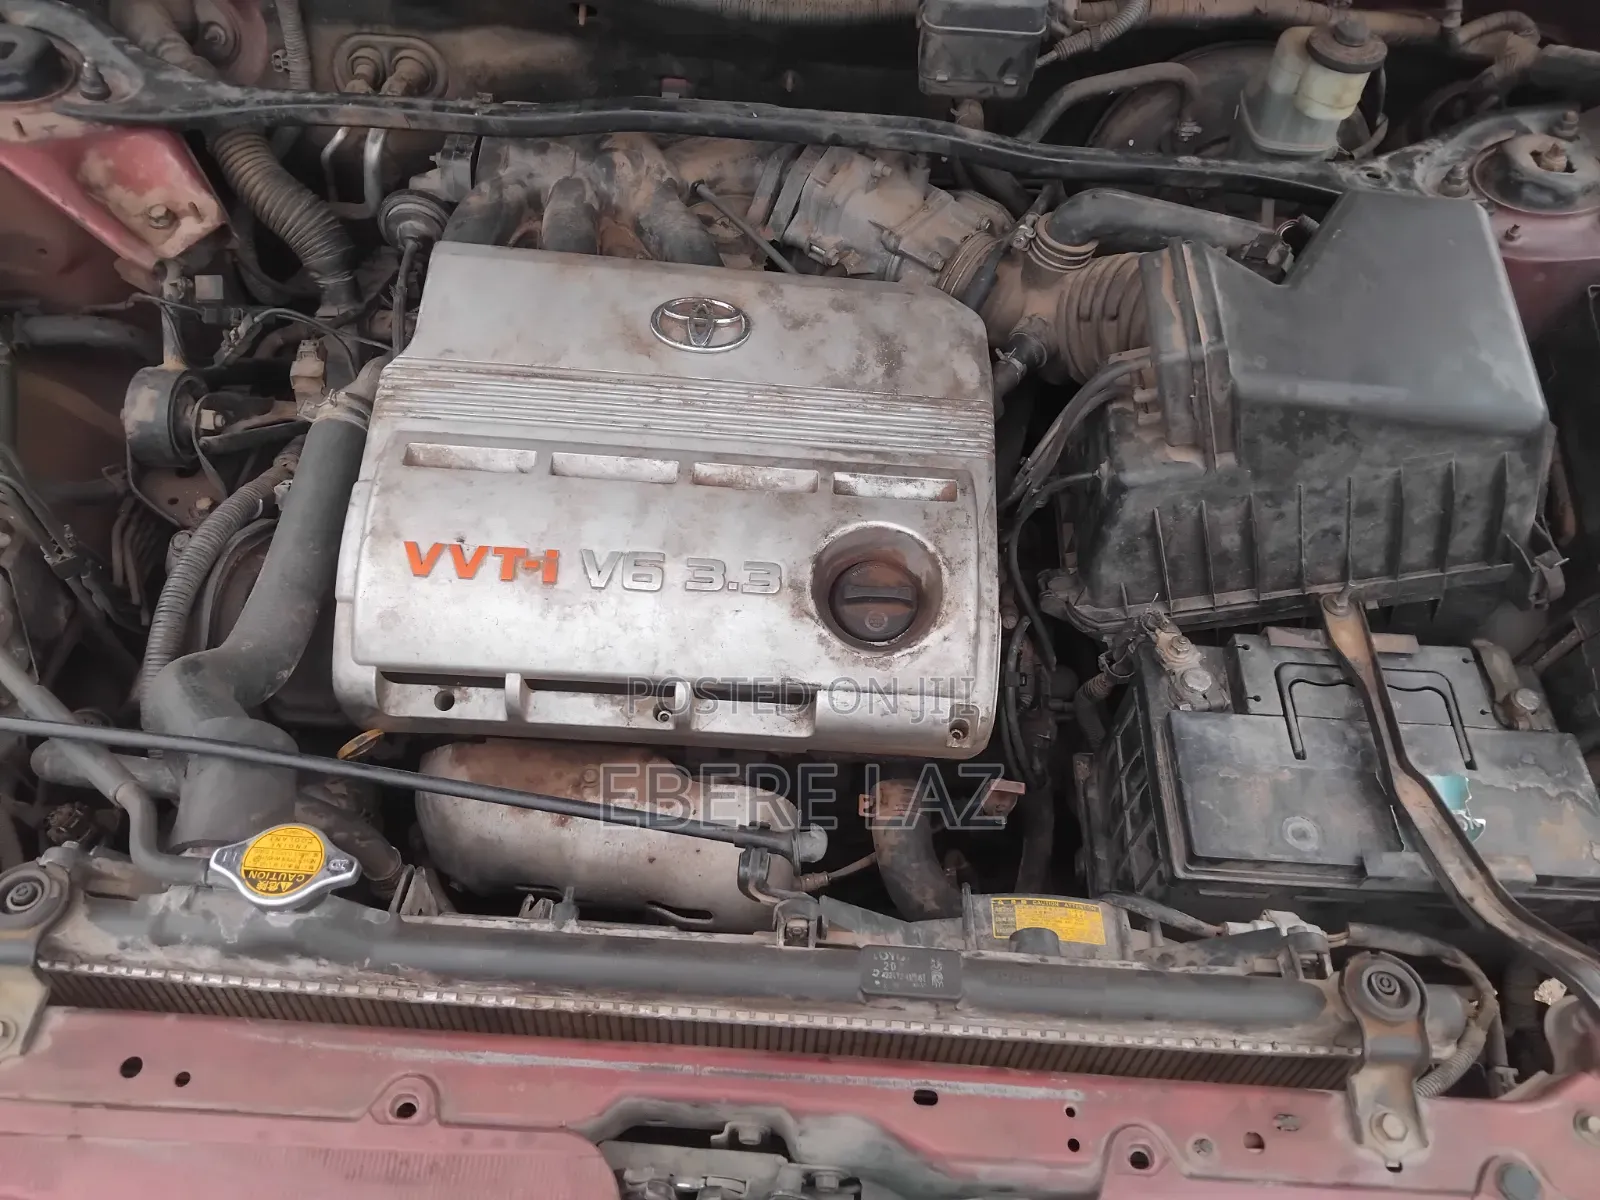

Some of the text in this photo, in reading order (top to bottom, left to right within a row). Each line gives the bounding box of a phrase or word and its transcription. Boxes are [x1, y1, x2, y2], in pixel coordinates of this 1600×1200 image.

[404, 540, 783, 595] VVT-i V6 3.3
[248, 870, 305, 882] CAUTION
[1032, 900, 1059, 908] CAUTION
